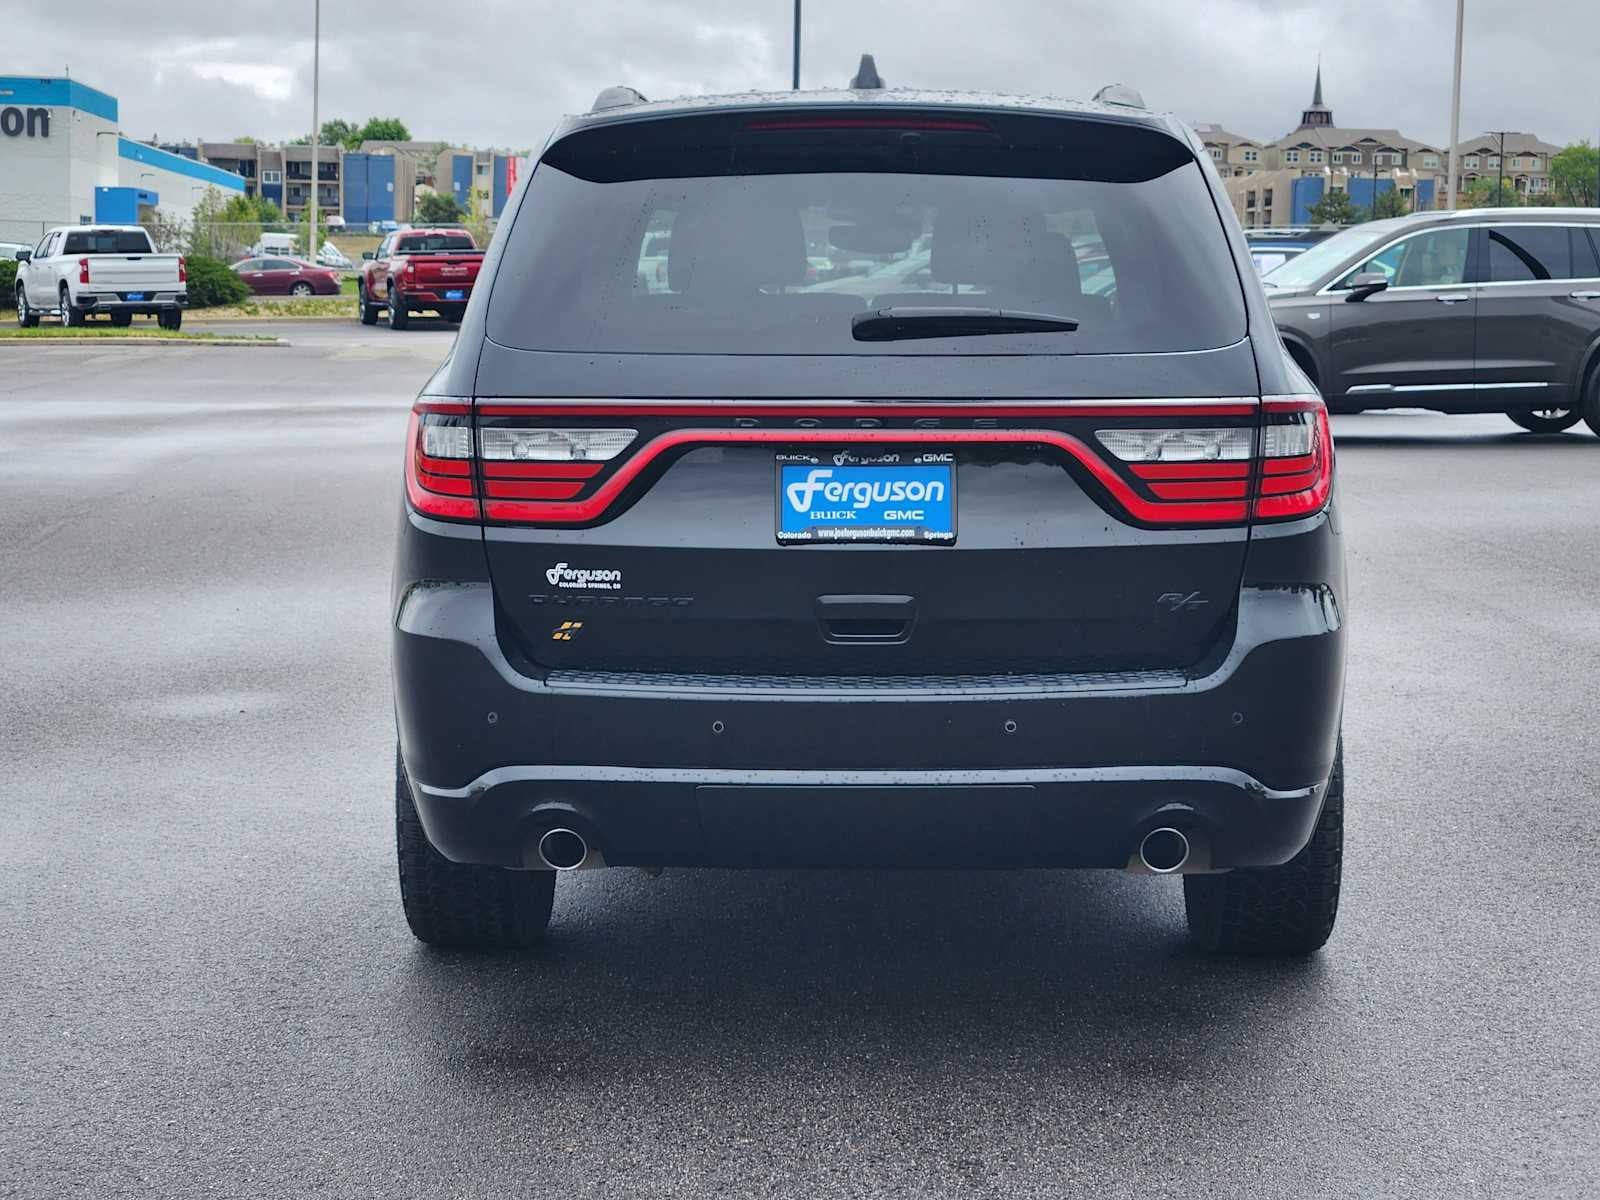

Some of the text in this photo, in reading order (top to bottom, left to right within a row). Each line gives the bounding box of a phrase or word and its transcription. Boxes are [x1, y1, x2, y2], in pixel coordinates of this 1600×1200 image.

[0, 106, 50, 138] on
[734, 417, 999, 429] DODGE
[922, 453, 954, 462] GMC
[786, 469, 945, 513] Ferguson
[810, 510, 857, 520] BUICK
[883, 510, 925, 520] GMC
[777, 531, 812, 539] Colorado
[545, 562, 622, 585] Ferguson
